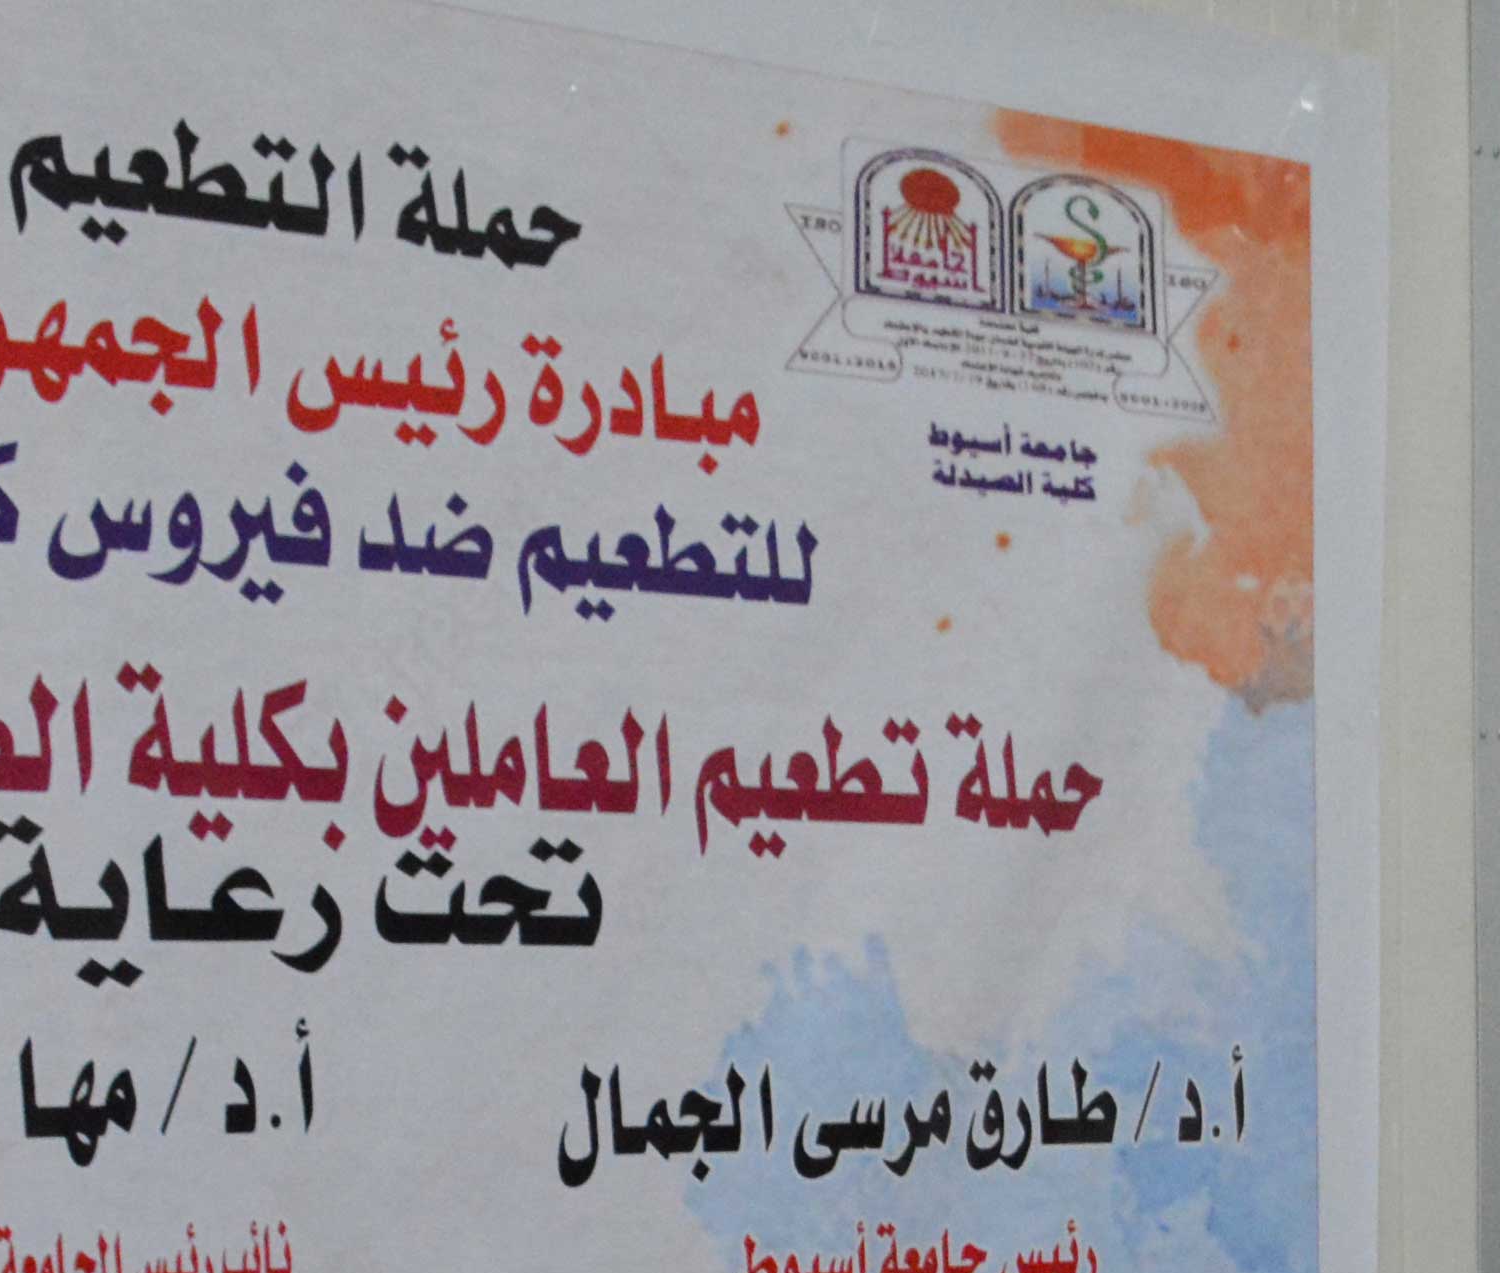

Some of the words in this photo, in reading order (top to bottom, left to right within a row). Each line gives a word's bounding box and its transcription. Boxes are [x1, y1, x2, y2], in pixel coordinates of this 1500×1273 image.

[10, 120, 364, 244] التطعيم
[388, 144, 581, 268] حملة
[288, 310, 506, 446] رئيس
[523, 335, 760, 474] مبادرة
[928, 421, 1012, 459] أسيوط
[932, 459, 1033, 497] الصيدلة
[1021, 432, 1098, 470] جامعة
[1041, 471, 1097, 506] كلية
[49, 462, 331, 603] فيروس
[359, 495, 492, 578] ضد
[518, 505, 817, 620] للتطعيم
[120, 666, 347, 848] بكلية
[377, 699, 670, 848] العاملين
[697, 722, 928, 855] تطعيم
[949, 716, 1100, 831] حملة
[376, 828, 602, 946] تحت
[20, 1040, 136, 1166] مها
[559, 1066, 772, 1187] الجمال
[794, 1091, 951, 1178] مرسى
[967, 1060, 1117, 1170] طارق
